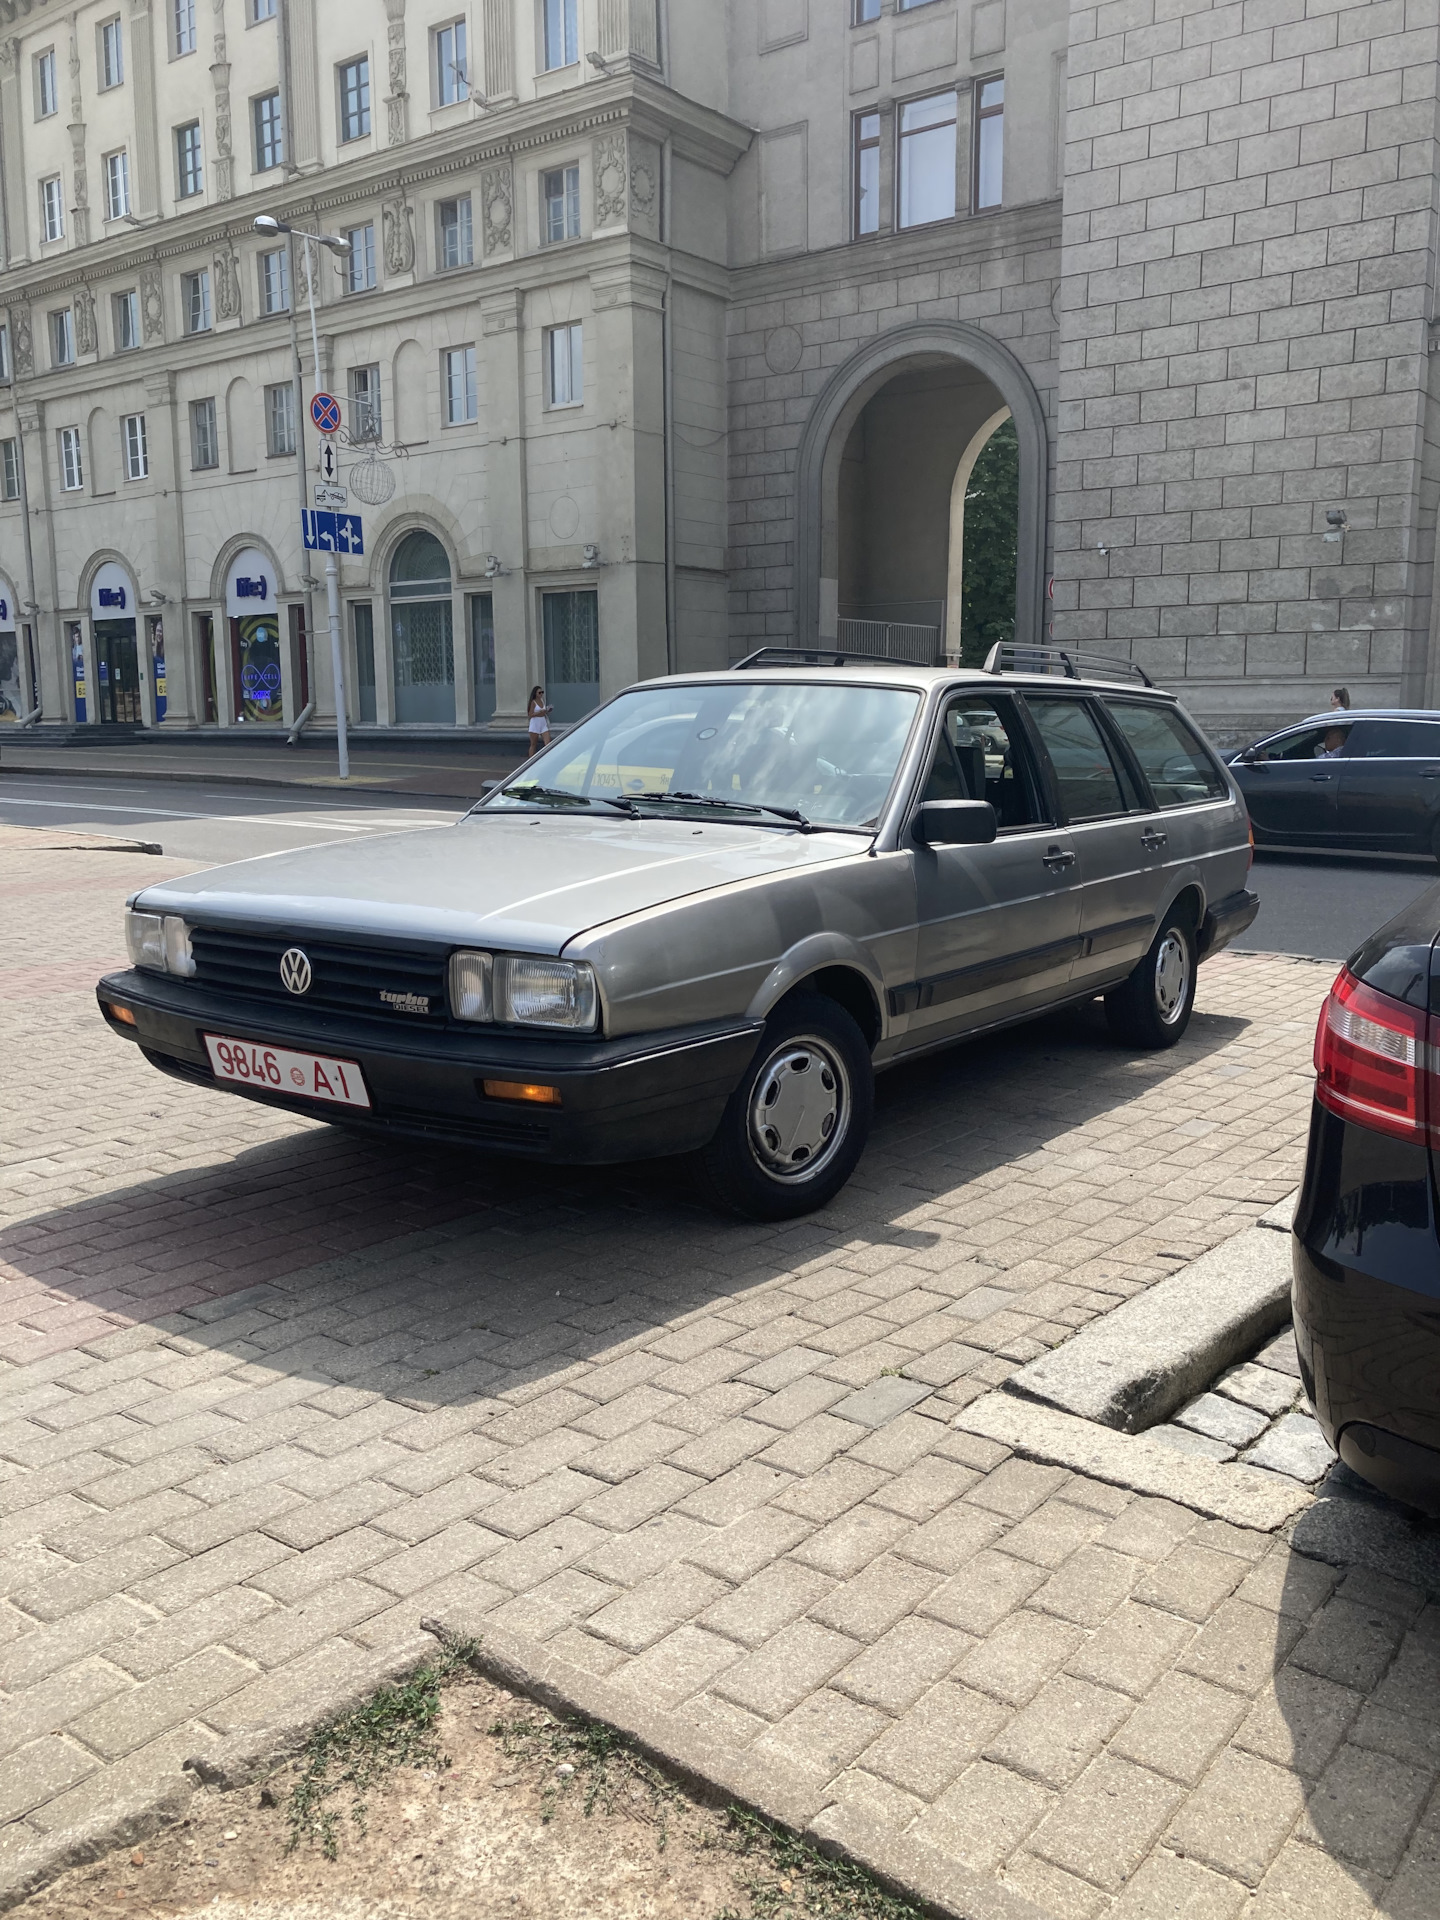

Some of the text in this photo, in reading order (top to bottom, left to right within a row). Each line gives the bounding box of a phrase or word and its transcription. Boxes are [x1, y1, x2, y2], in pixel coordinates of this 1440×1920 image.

[244, 673, 258, 681] LIFE
[379, 989, 429, 1006] turbo
[393, 1003, 430, 1014] DIESEL
[216, 1042, 282, 1085] 9846
